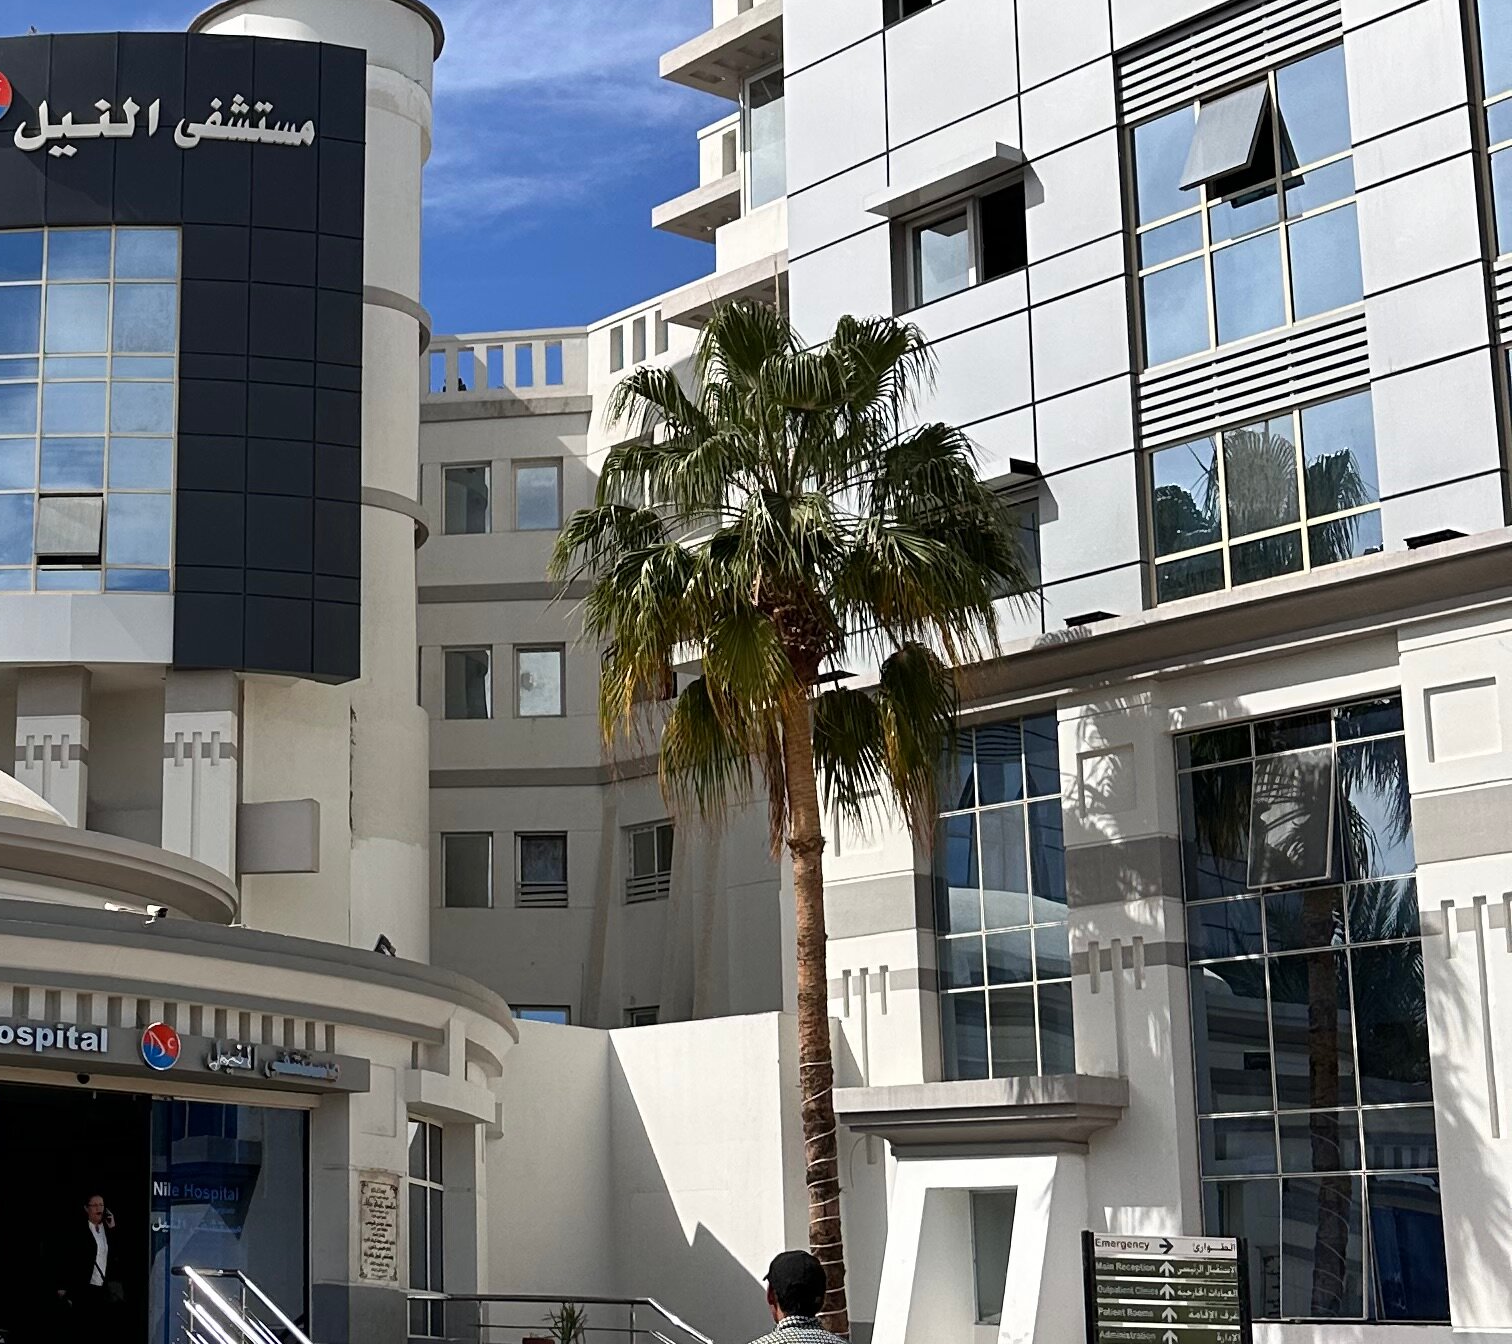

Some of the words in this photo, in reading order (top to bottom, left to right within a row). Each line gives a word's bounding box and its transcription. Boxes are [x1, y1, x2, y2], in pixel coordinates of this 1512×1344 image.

[14, 96, 160, 157] النيل
[173, 94, 316, 149] مستشفى
[153, 1181, 180, 1197] Nile
[184, 1184, 239, 1202] Hospital
[1095, 1238, 1150, 1251] Emergency
[1095, 1262, 1114, 1271] Main
[1115, 1262, 1156, 1272] Reception
[1098, 1307, 1126, 1317] Patient
[1127, 1308, 1154, 1318] Rooms
[1099, 1330, 1156, 1340] Administration
